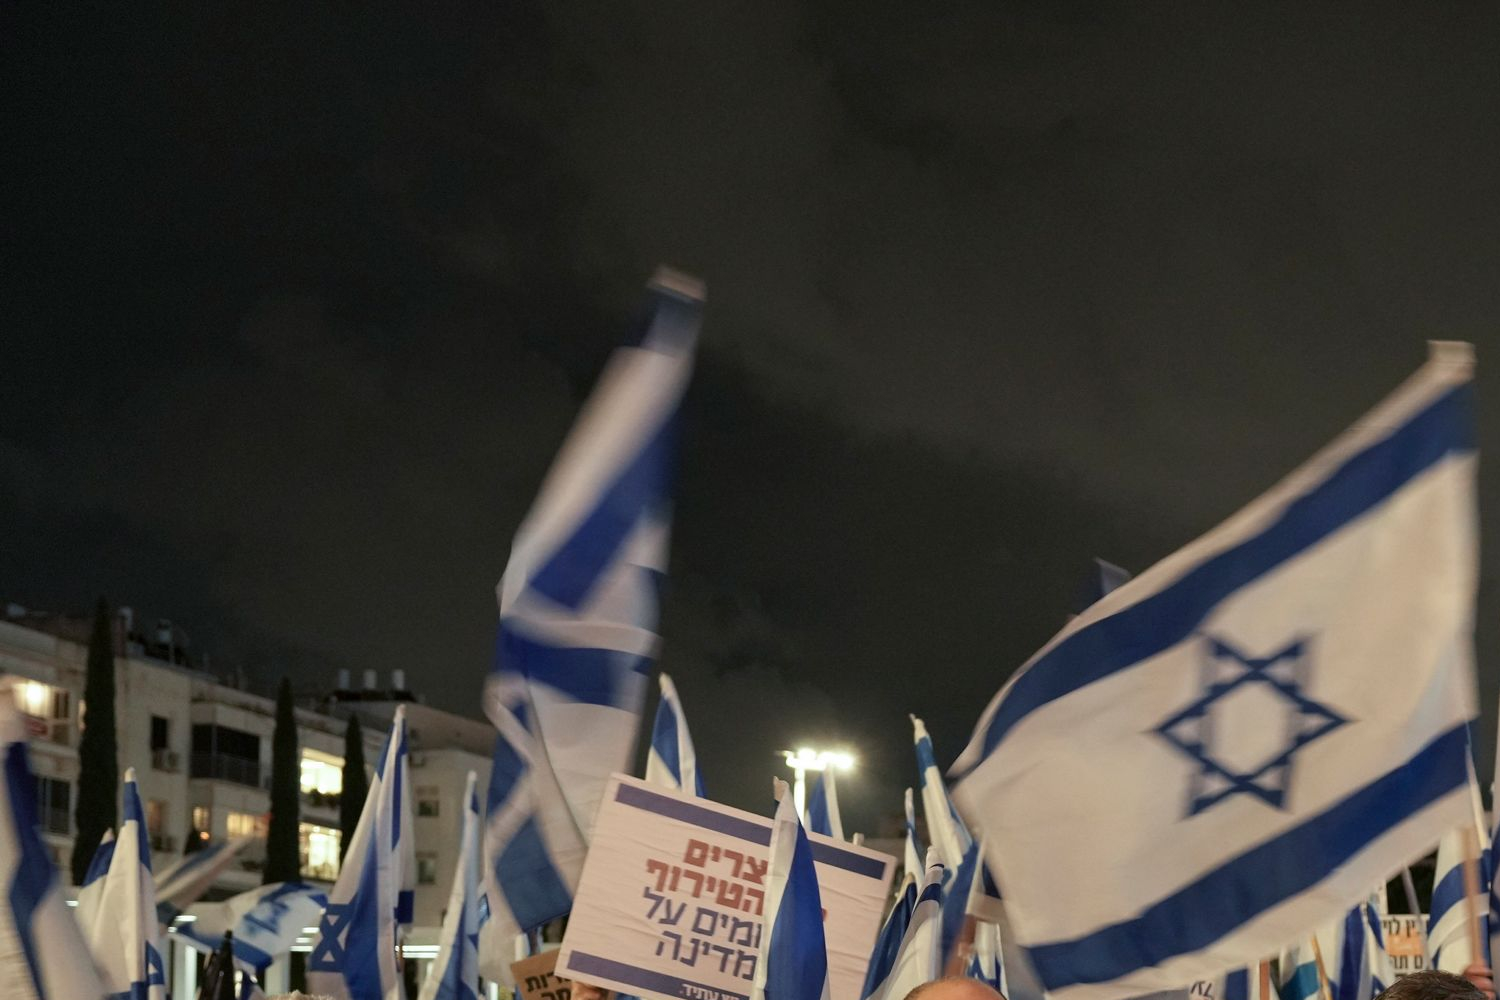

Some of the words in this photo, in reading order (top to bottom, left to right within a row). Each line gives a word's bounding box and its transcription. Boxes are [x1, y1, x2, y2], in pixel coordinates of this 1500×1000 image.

[683, 838, 769, 886] צרים
[643, 886, 688, 926] על
[646, 858, 765, 916] הטירוף
[655, 930, 758, 981] מדינה
